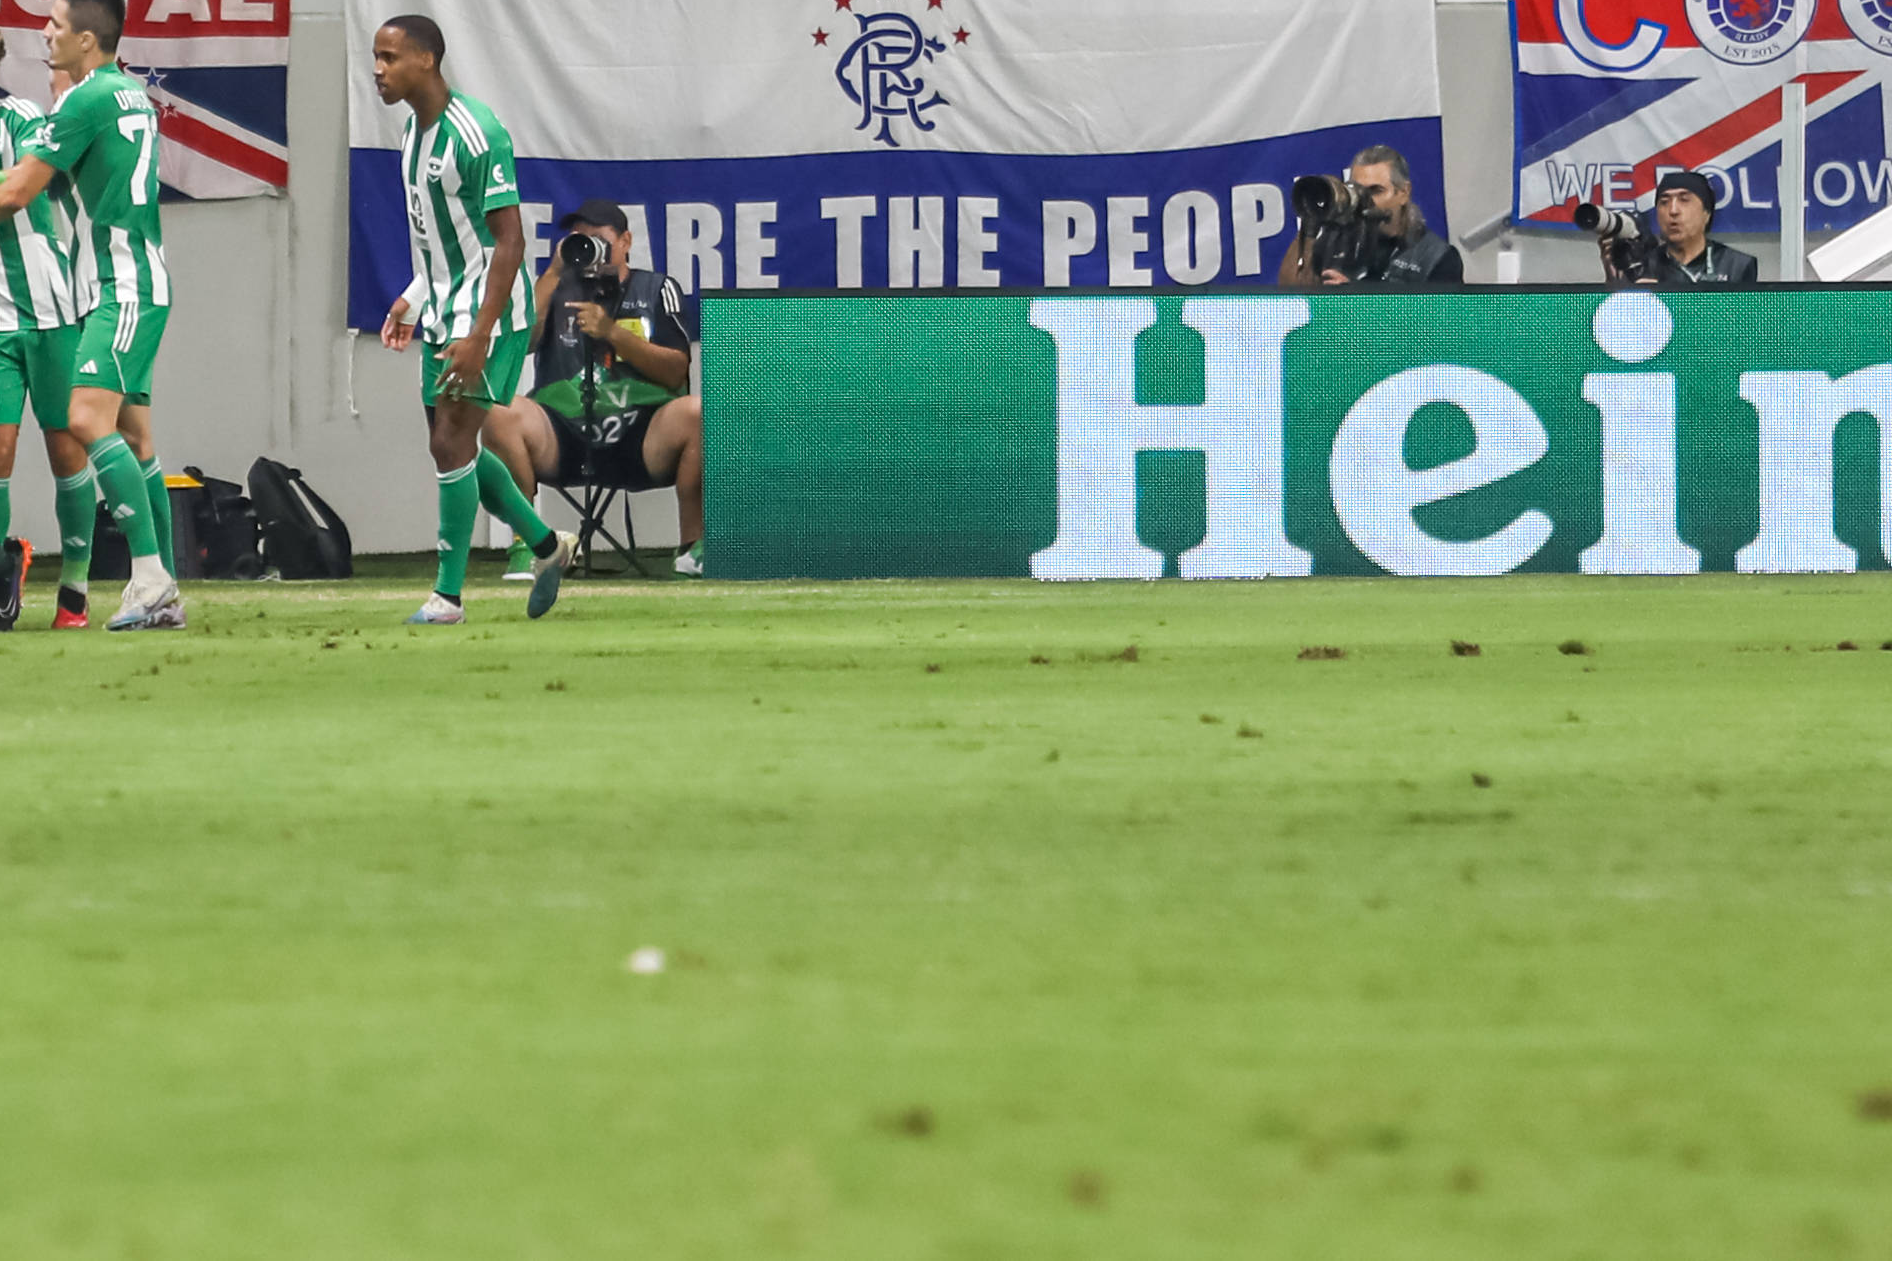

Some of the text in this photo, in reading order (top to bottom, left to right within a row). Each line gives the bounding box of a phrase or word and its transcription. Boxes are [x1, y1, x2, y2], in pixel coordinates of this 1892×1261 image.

[1724, 44, 1748, 58] EST
[1545, 159, 1635, 210] WE
[521, 202, 554, 288] E
[820, 195, 1001, 287] THE
[1041, 184, 1286, 287] PEOP
